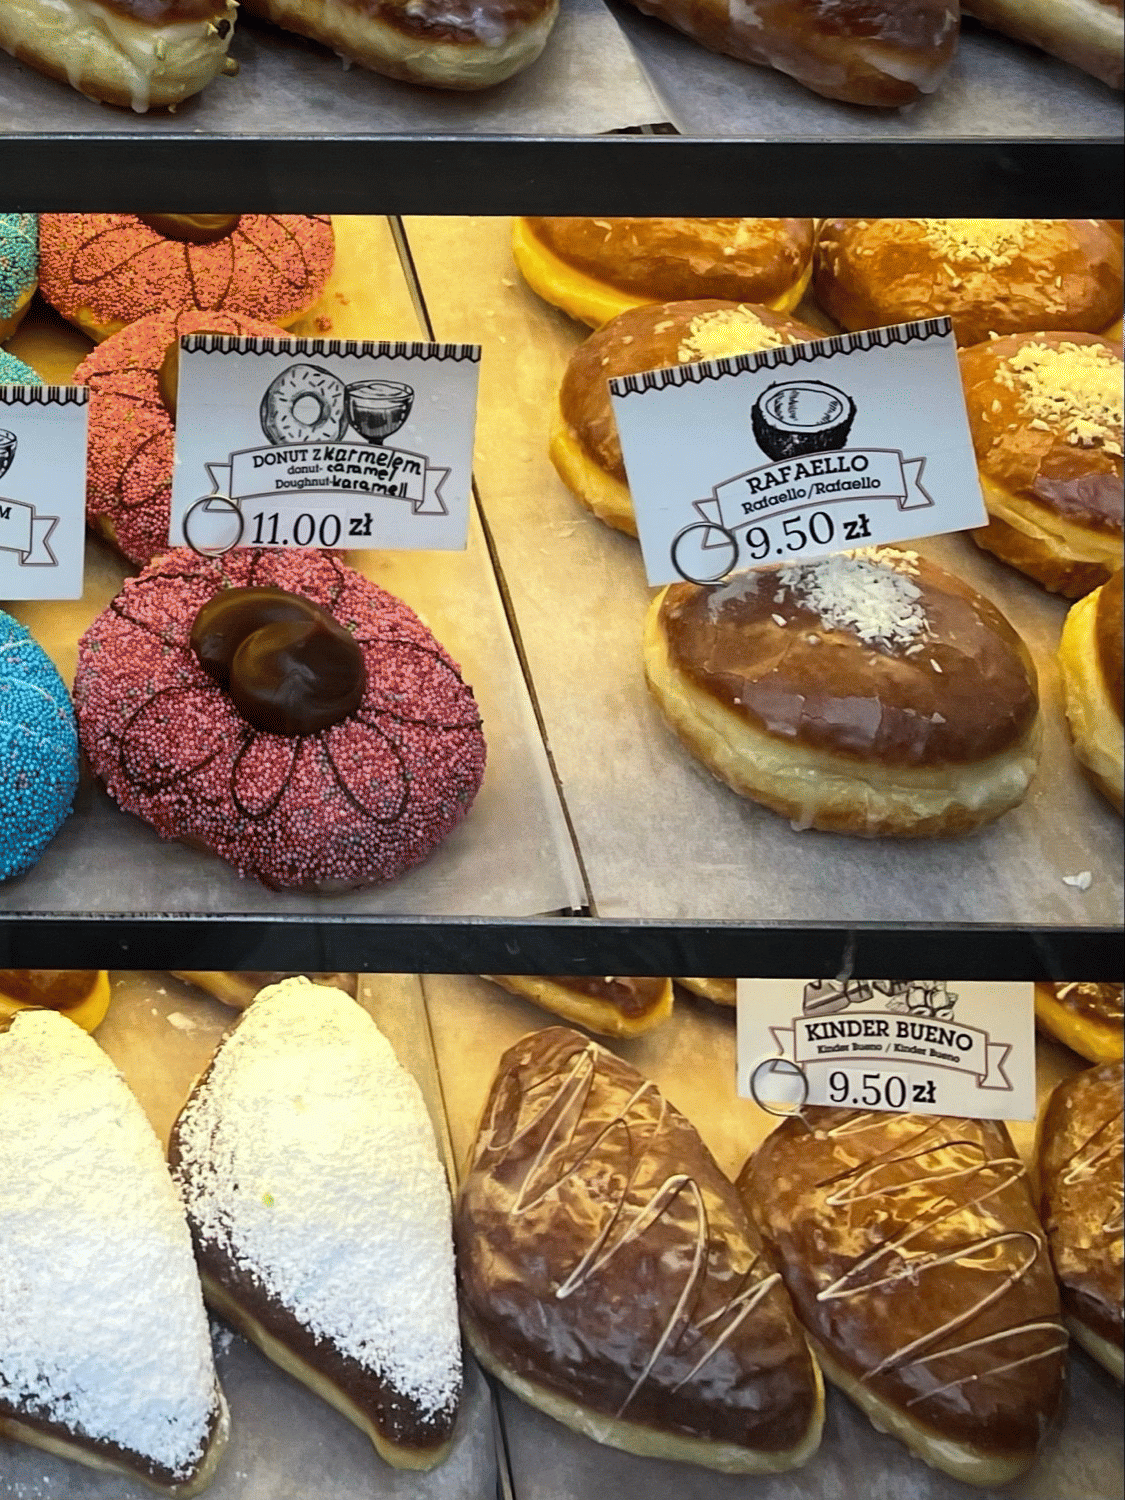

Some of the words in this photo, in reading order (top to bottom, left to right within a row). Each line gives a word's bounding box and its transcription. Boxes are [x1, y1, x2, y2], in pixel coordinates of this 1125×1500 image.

[253, 449, 309, 468] DONUT
[746, 455, 869, 494] RAFAELLO
[742, 477, 881, 515] Rafaello/Rafaello
[251, 512, 341, 547] 11.00
[348, 513, 374, 536] zł
[746, 511, 835, 560] 9.50
[843, 513, 872, 541] zł
[805, 1020, 889, 1041] KINDER
[896, 1023, 973, 1050] BUENO
[817, 1043, 849, 1054] Kinder
[852, 1043, 883, 1051] Bueno
[893, 1044, 927, 1056] Kinder
[929, 1048, 960, 1063] Bueno
[829, 1072, 907, 1108] 9.50
[913, 1080, 937, 1104] zł
